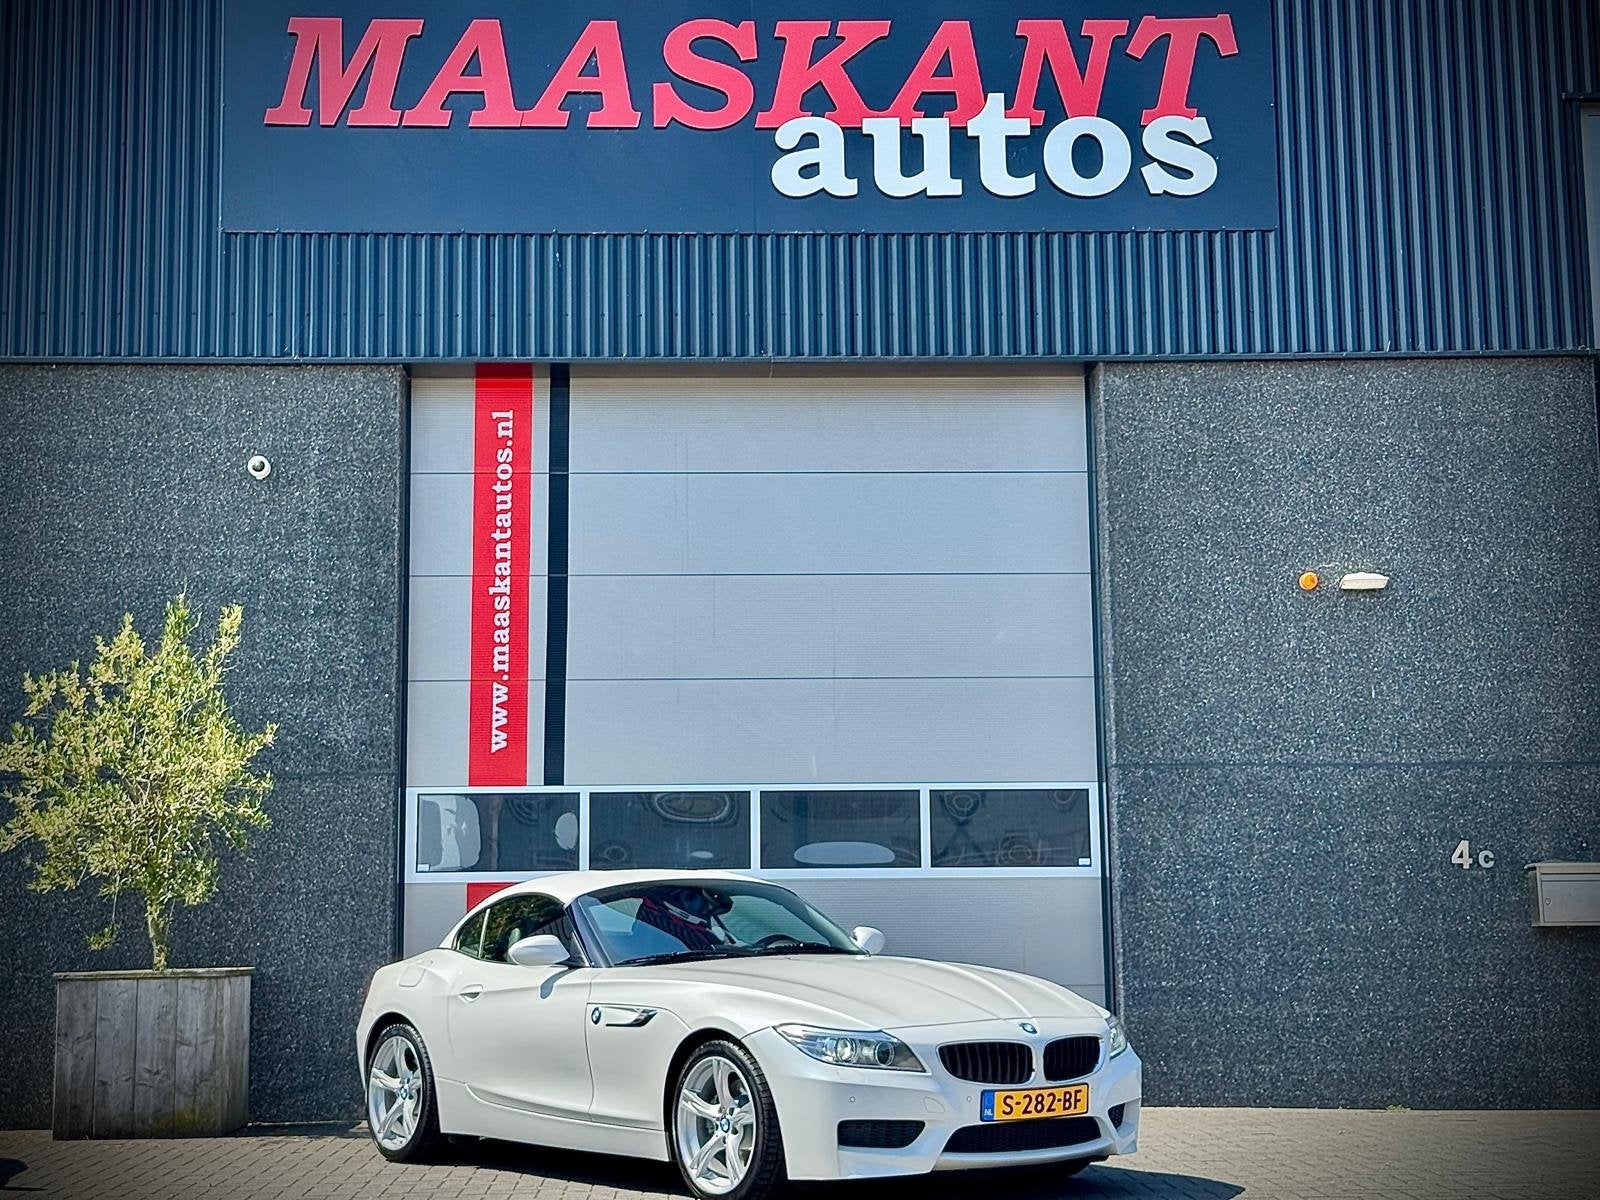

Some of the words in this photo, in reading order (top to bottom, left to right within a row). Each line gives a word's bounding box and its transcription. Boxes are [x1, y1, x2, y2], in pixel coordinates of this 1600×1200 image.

[264, 14, 1239, 129] MAASKANT
[771, 92, 1218, 197] autos
[488, 409, 514, 753] www.maaskantautos.nl
[984, 1108, 993, 1116] NL
[1002, 1089, 1083, 1116] S-282-BF
